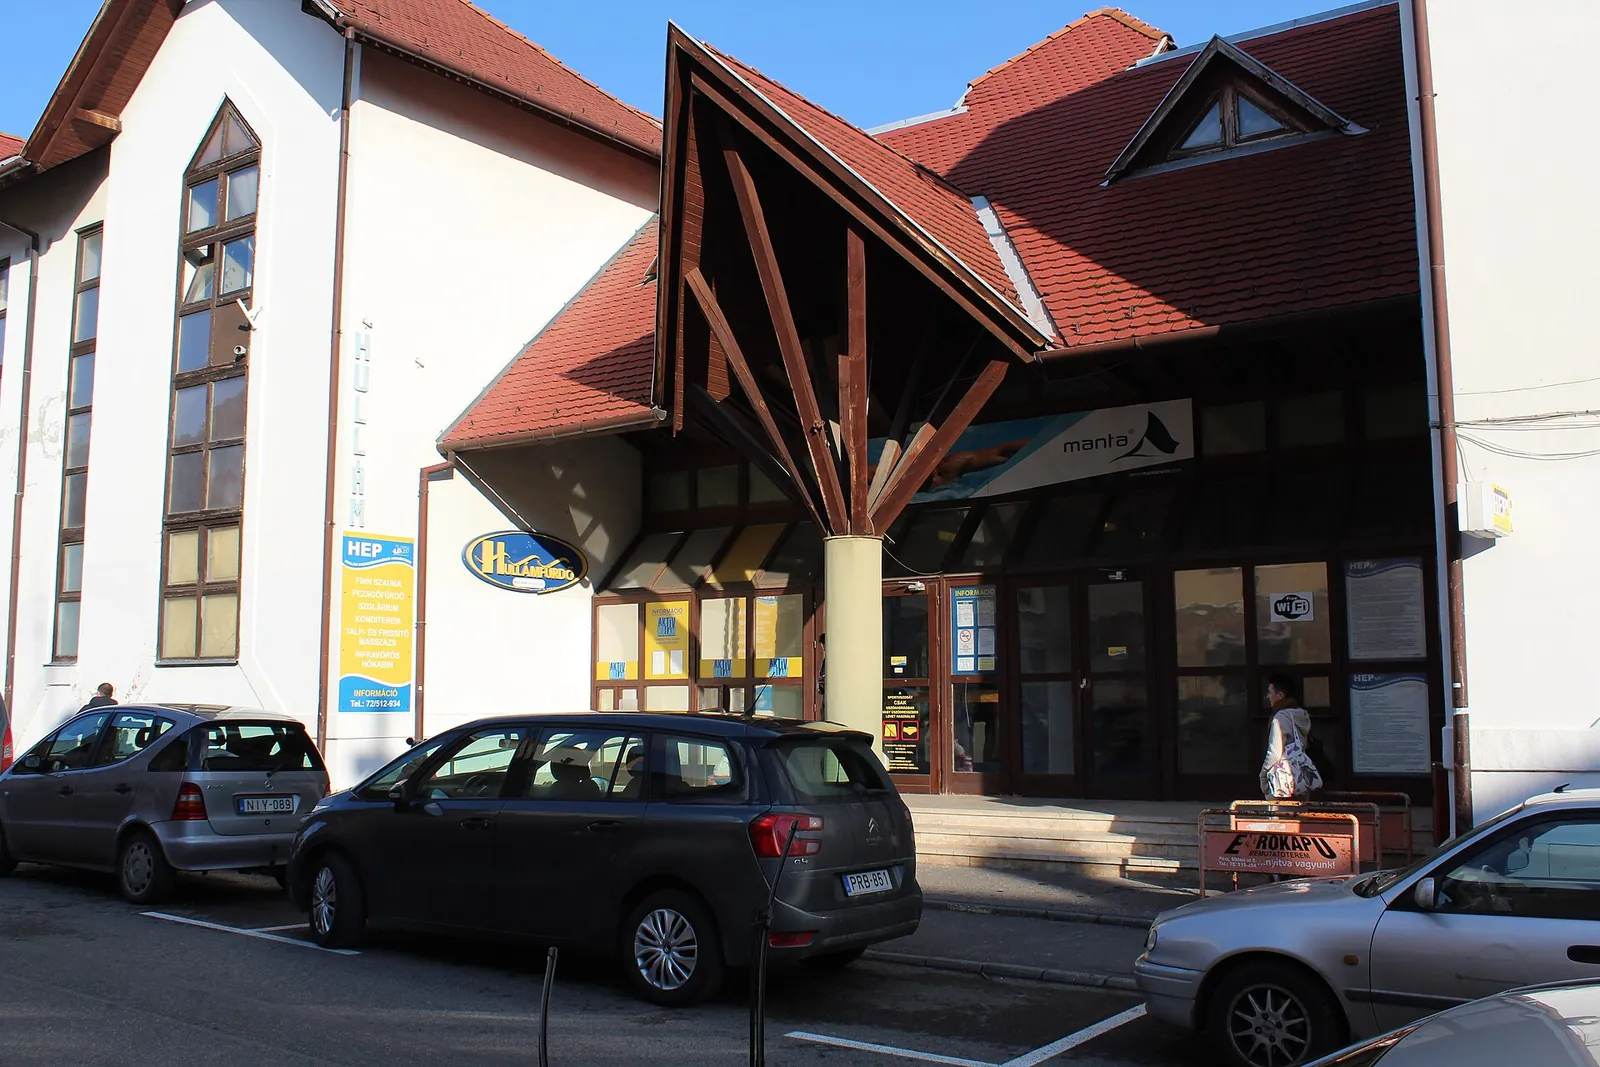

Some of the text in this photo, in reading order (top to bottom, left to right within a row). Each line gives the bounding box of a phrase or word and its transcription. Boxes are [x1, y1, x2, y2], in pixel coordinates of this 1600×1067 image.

[1063, 433, 1128, 453] manta
[347, 540, 383, 558] HEP
[1349, 561, 1370, 570] HEP
[355, 576, 402, 588] FINN SZAUNA
[955, 587, 996, 597] INFORMÁCIÓ
[354, 615, 402, 624] KONDITEREM
[1353, 674, 1374, 682] HEP
[353, 688, 398, 697] INFORMÁCIÓ
[246, 799, 291, 811] NIY-089
[1224, 834, 1337, 860] EROKAPU
[1295, 860, 1336, 870] vagyunk!
[850, 871, 890, 891] PRB-851
